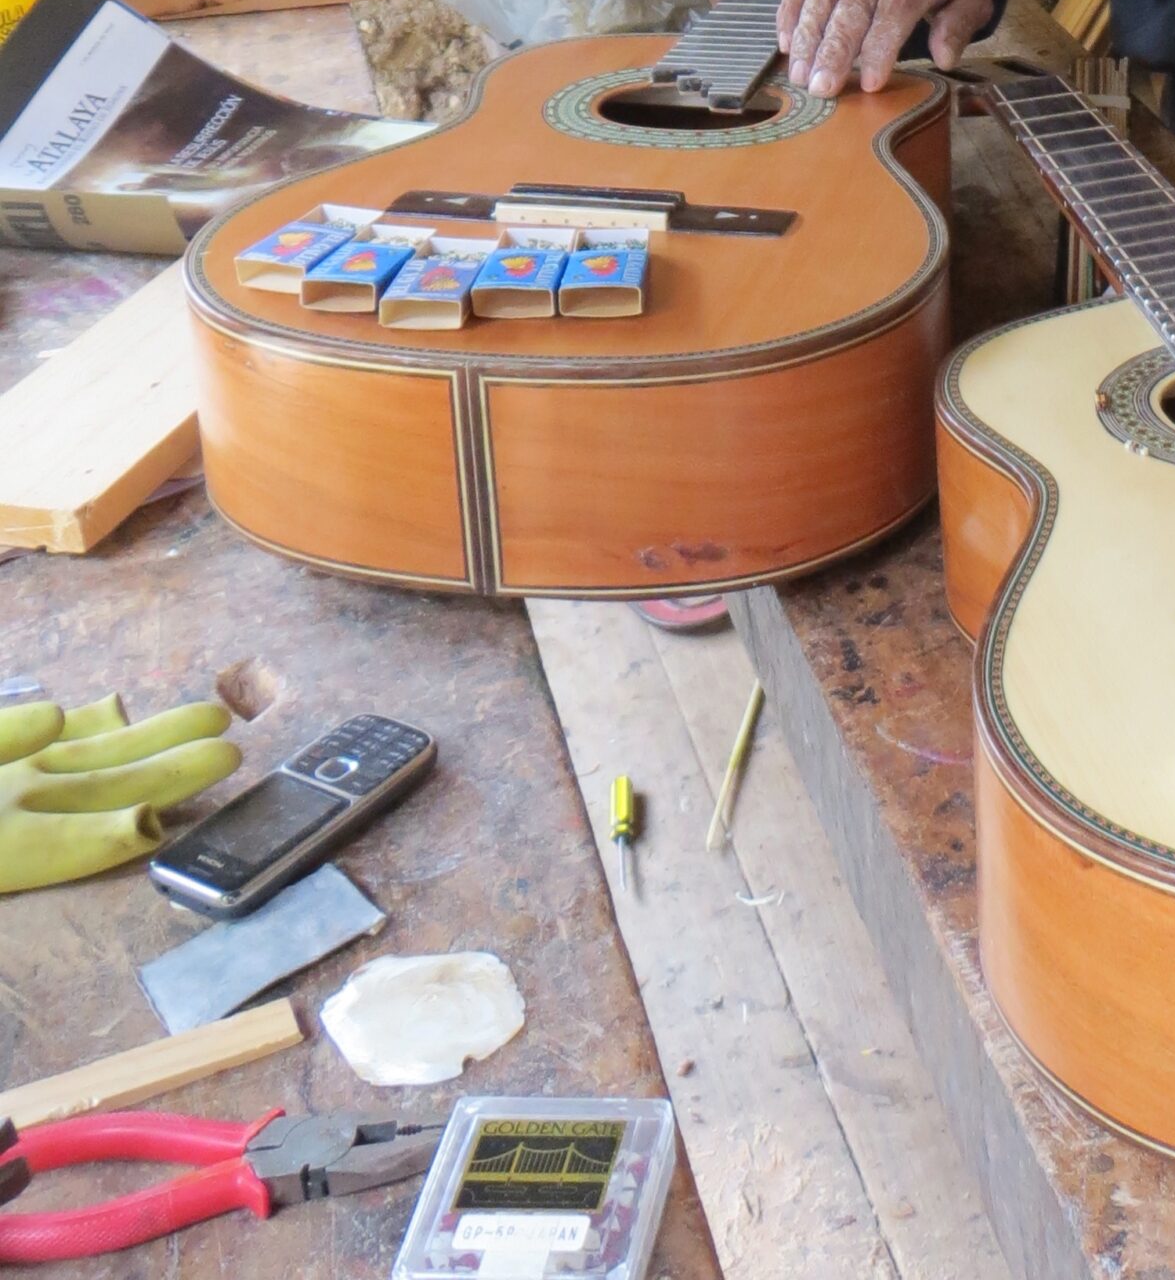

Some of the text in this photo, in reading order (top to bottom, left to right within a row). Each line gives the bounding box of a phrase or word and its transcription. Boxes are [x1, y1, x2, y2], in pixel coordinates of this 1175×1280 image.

[26, 93, 108, 173] ATALAYA
[175, 94, 243, 159] RESURRECCIÓN
[483, 1121, 622, 1137] GOLDEN GATE
